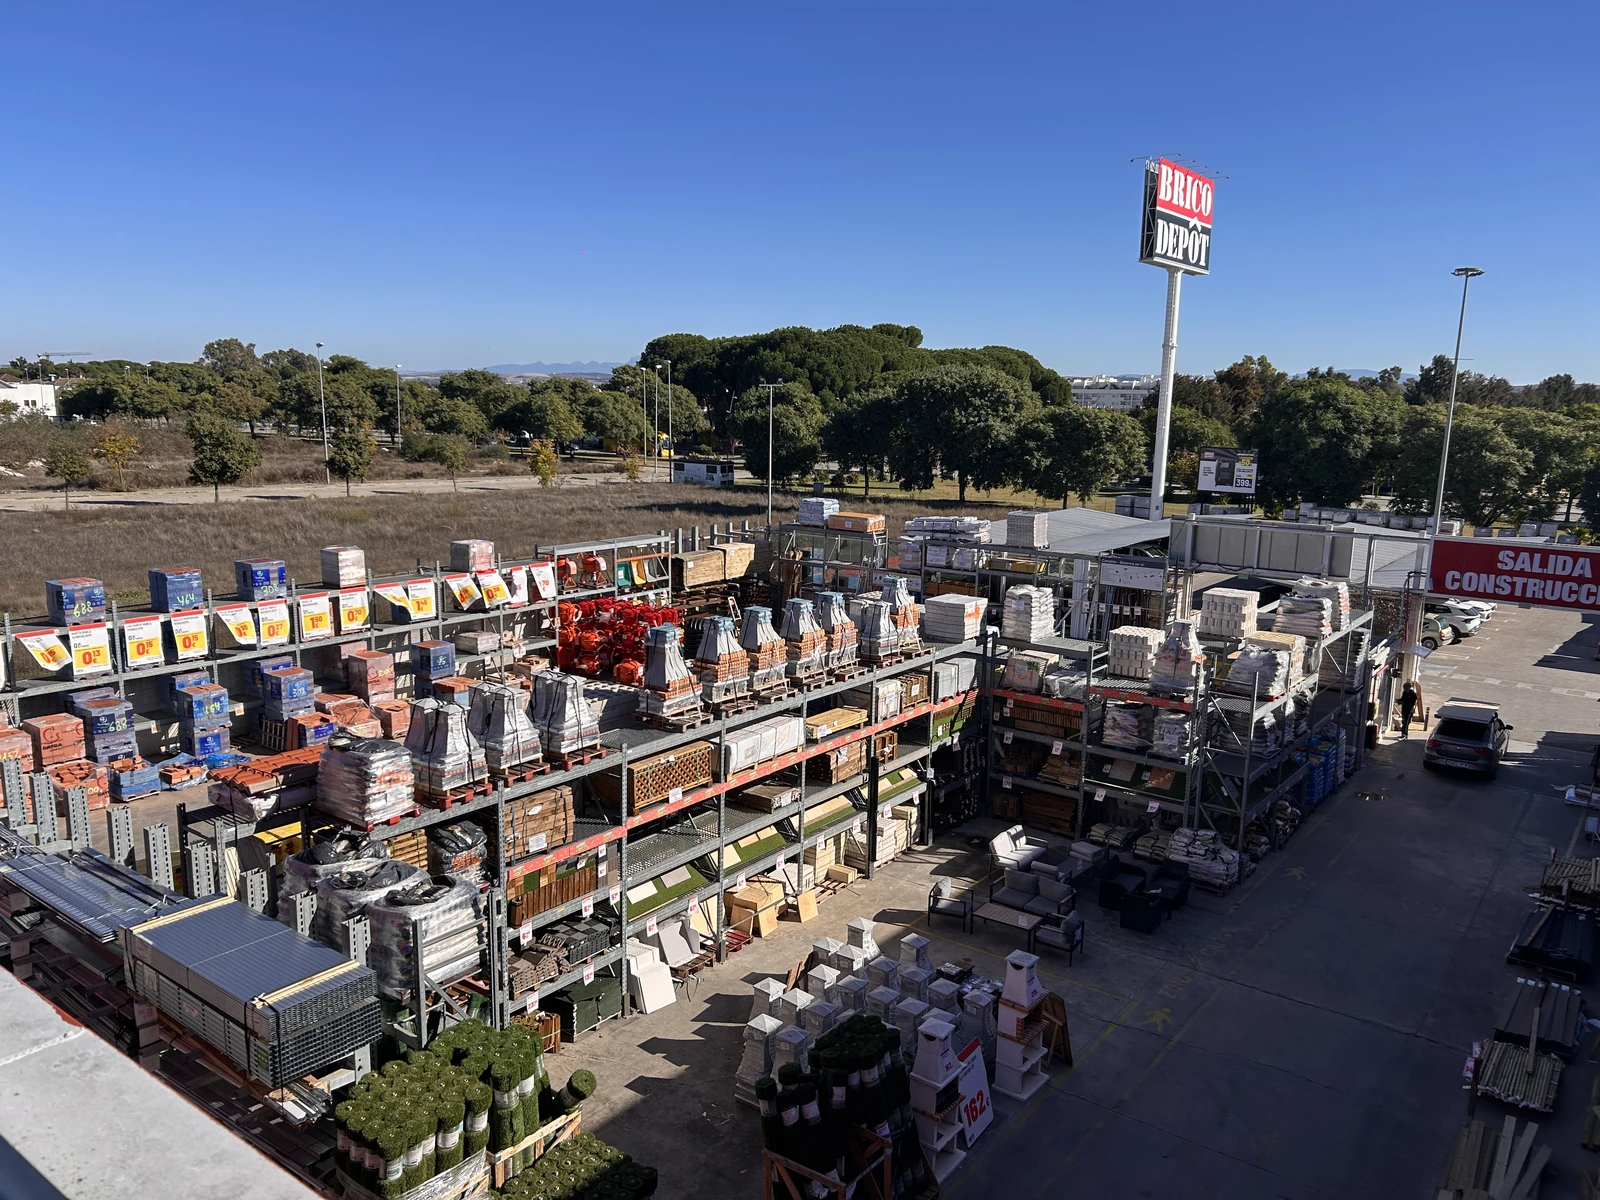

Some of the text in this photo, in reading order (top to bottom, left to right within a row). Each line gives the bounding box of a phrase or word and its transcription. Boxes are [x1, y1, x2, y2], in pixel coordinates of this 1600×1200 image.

[1159, 164, 1212, 217] BRICO
[1497, 549, 1592, 578] SALIDA
[73, 600, 93, 618] 688
[108, 717, 128, 732] 688
